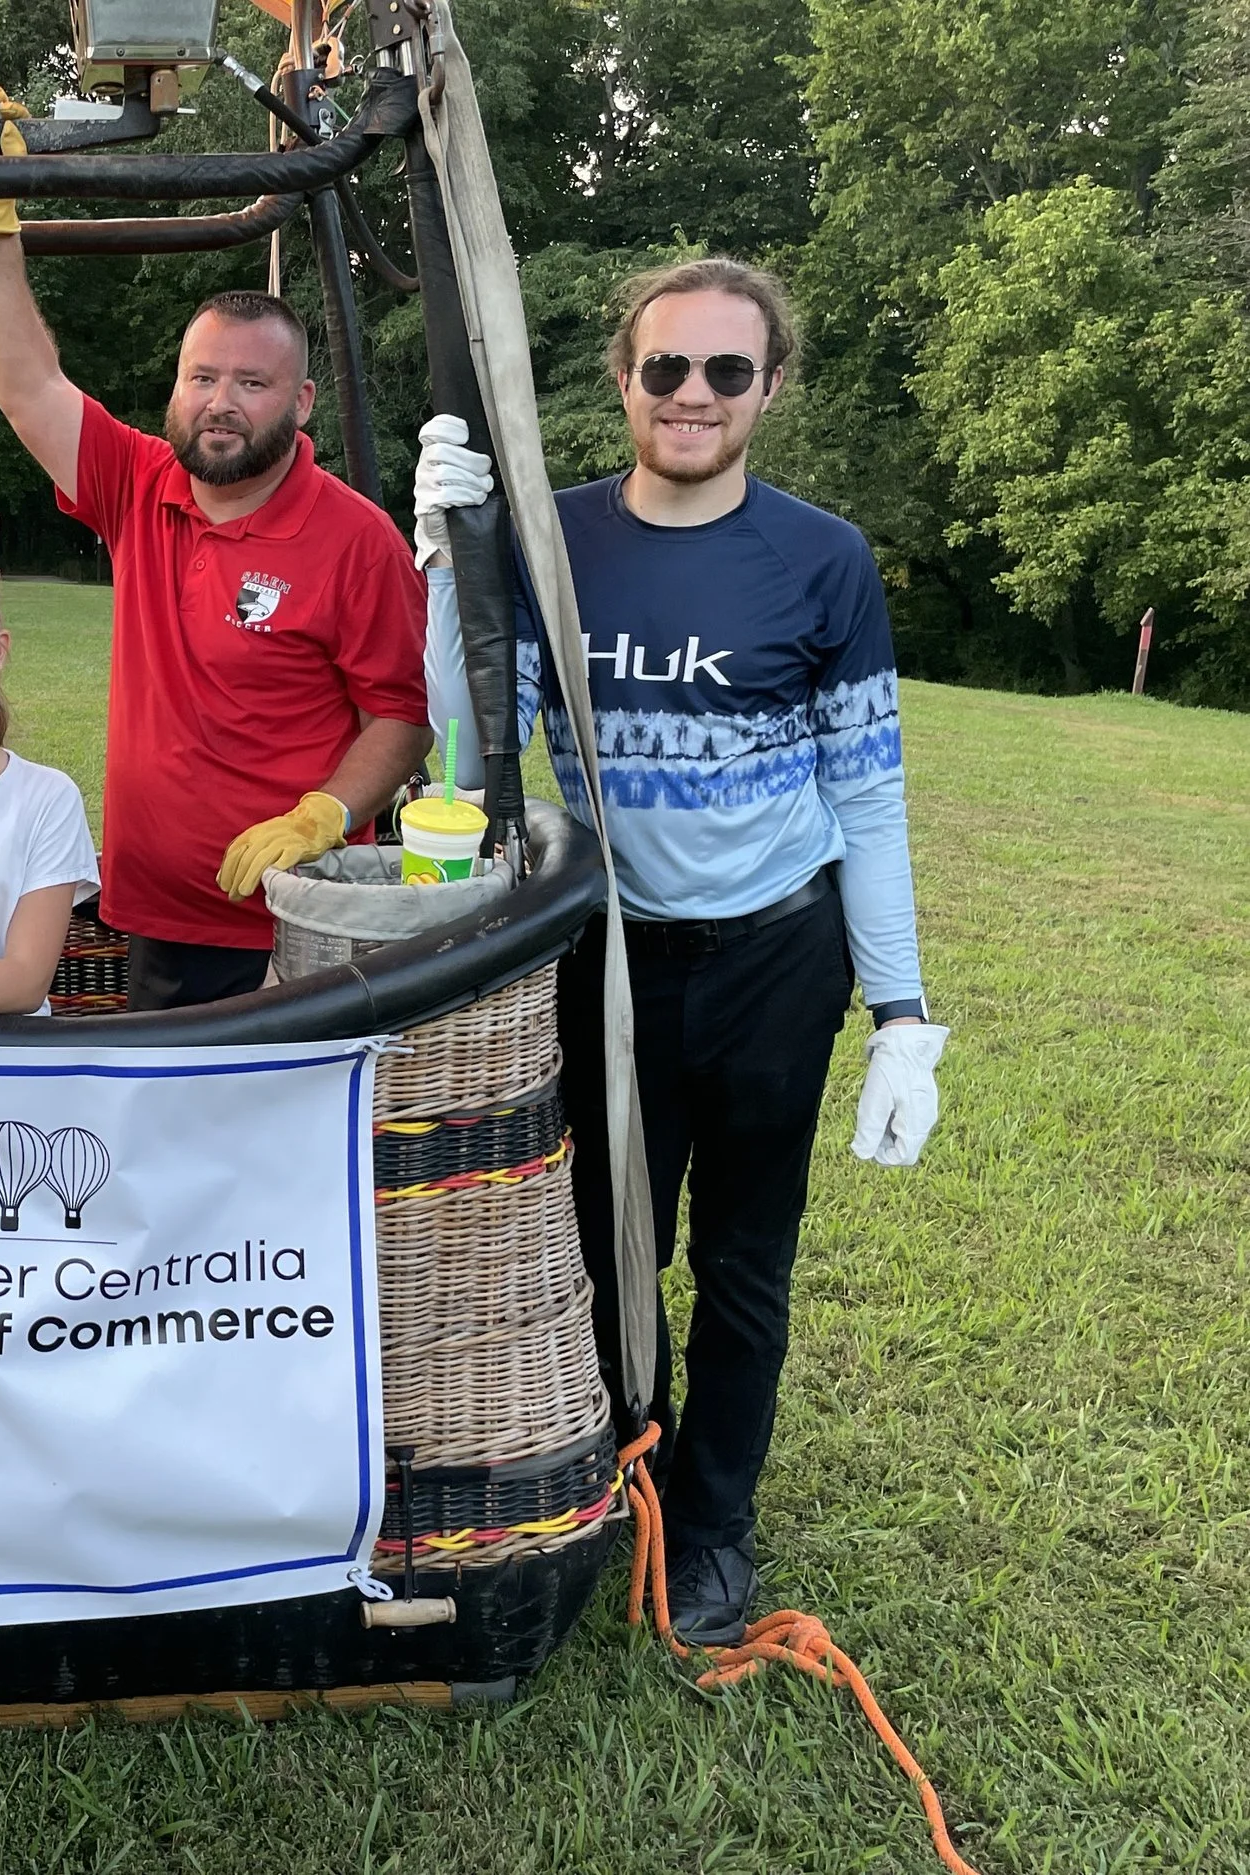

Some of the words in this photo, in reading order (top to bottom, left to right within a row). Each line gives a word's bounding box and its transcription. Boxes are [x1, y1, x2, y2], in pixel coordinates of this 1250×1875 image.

[241, 571, 291, 594] SALEM
[54, 1240, 306, 1301] Centralia
[27, 1305, 336, 1353] Commerce
